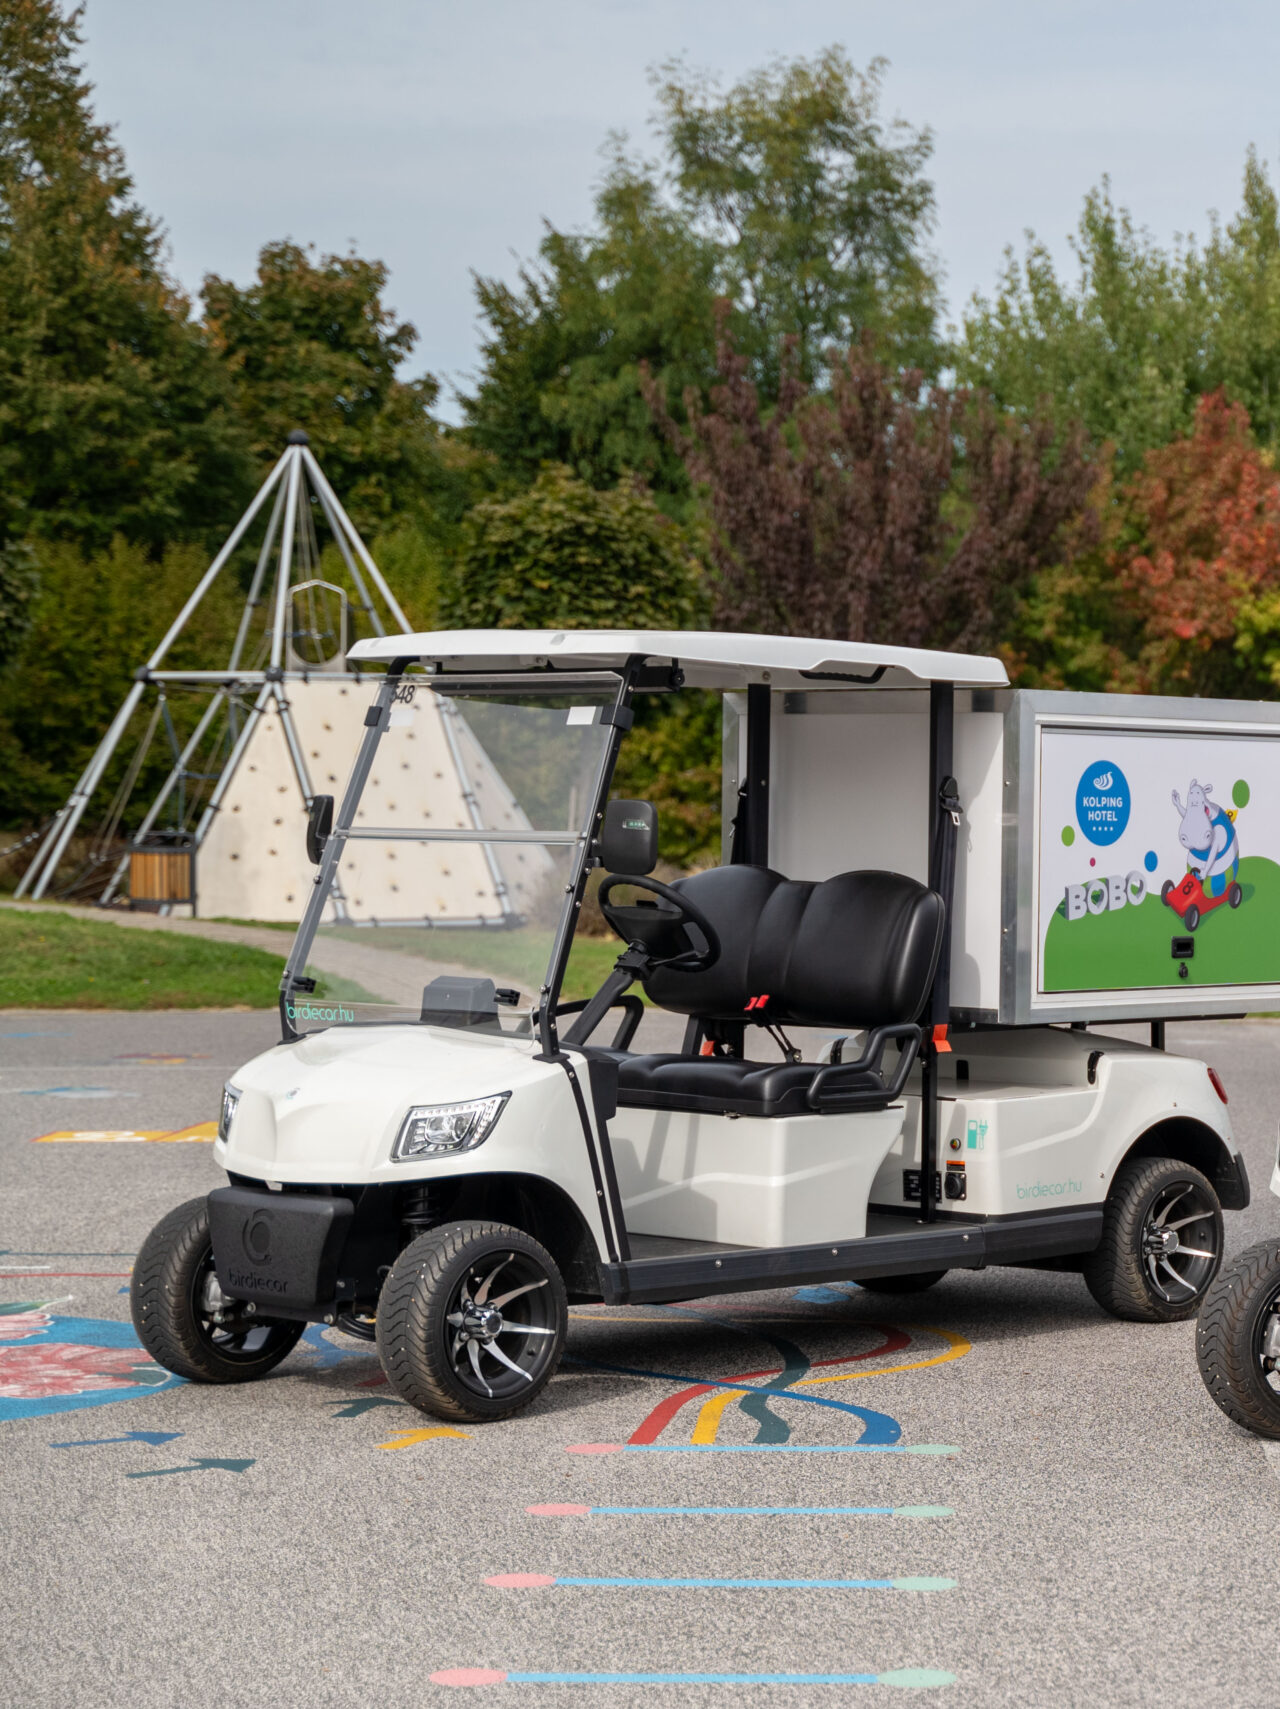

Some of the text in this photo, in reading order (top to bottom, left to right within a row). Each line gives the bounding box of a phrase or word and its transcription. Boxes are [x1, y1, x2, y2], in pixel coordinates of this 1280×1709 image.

[1083, 796, 1123, 808] KOLPING
[1088, 810, 1118, 822] HOTEL
[1064, 869, 1148, 921] BOBO
[1182, 881, 1194, 895] 8
[285, 1001, 354, 1022] birdiecar.hu
[1016, 1178, 1083, 1200] birdiecar.hu
[228, 1267, 289, 1294] birdiecar
